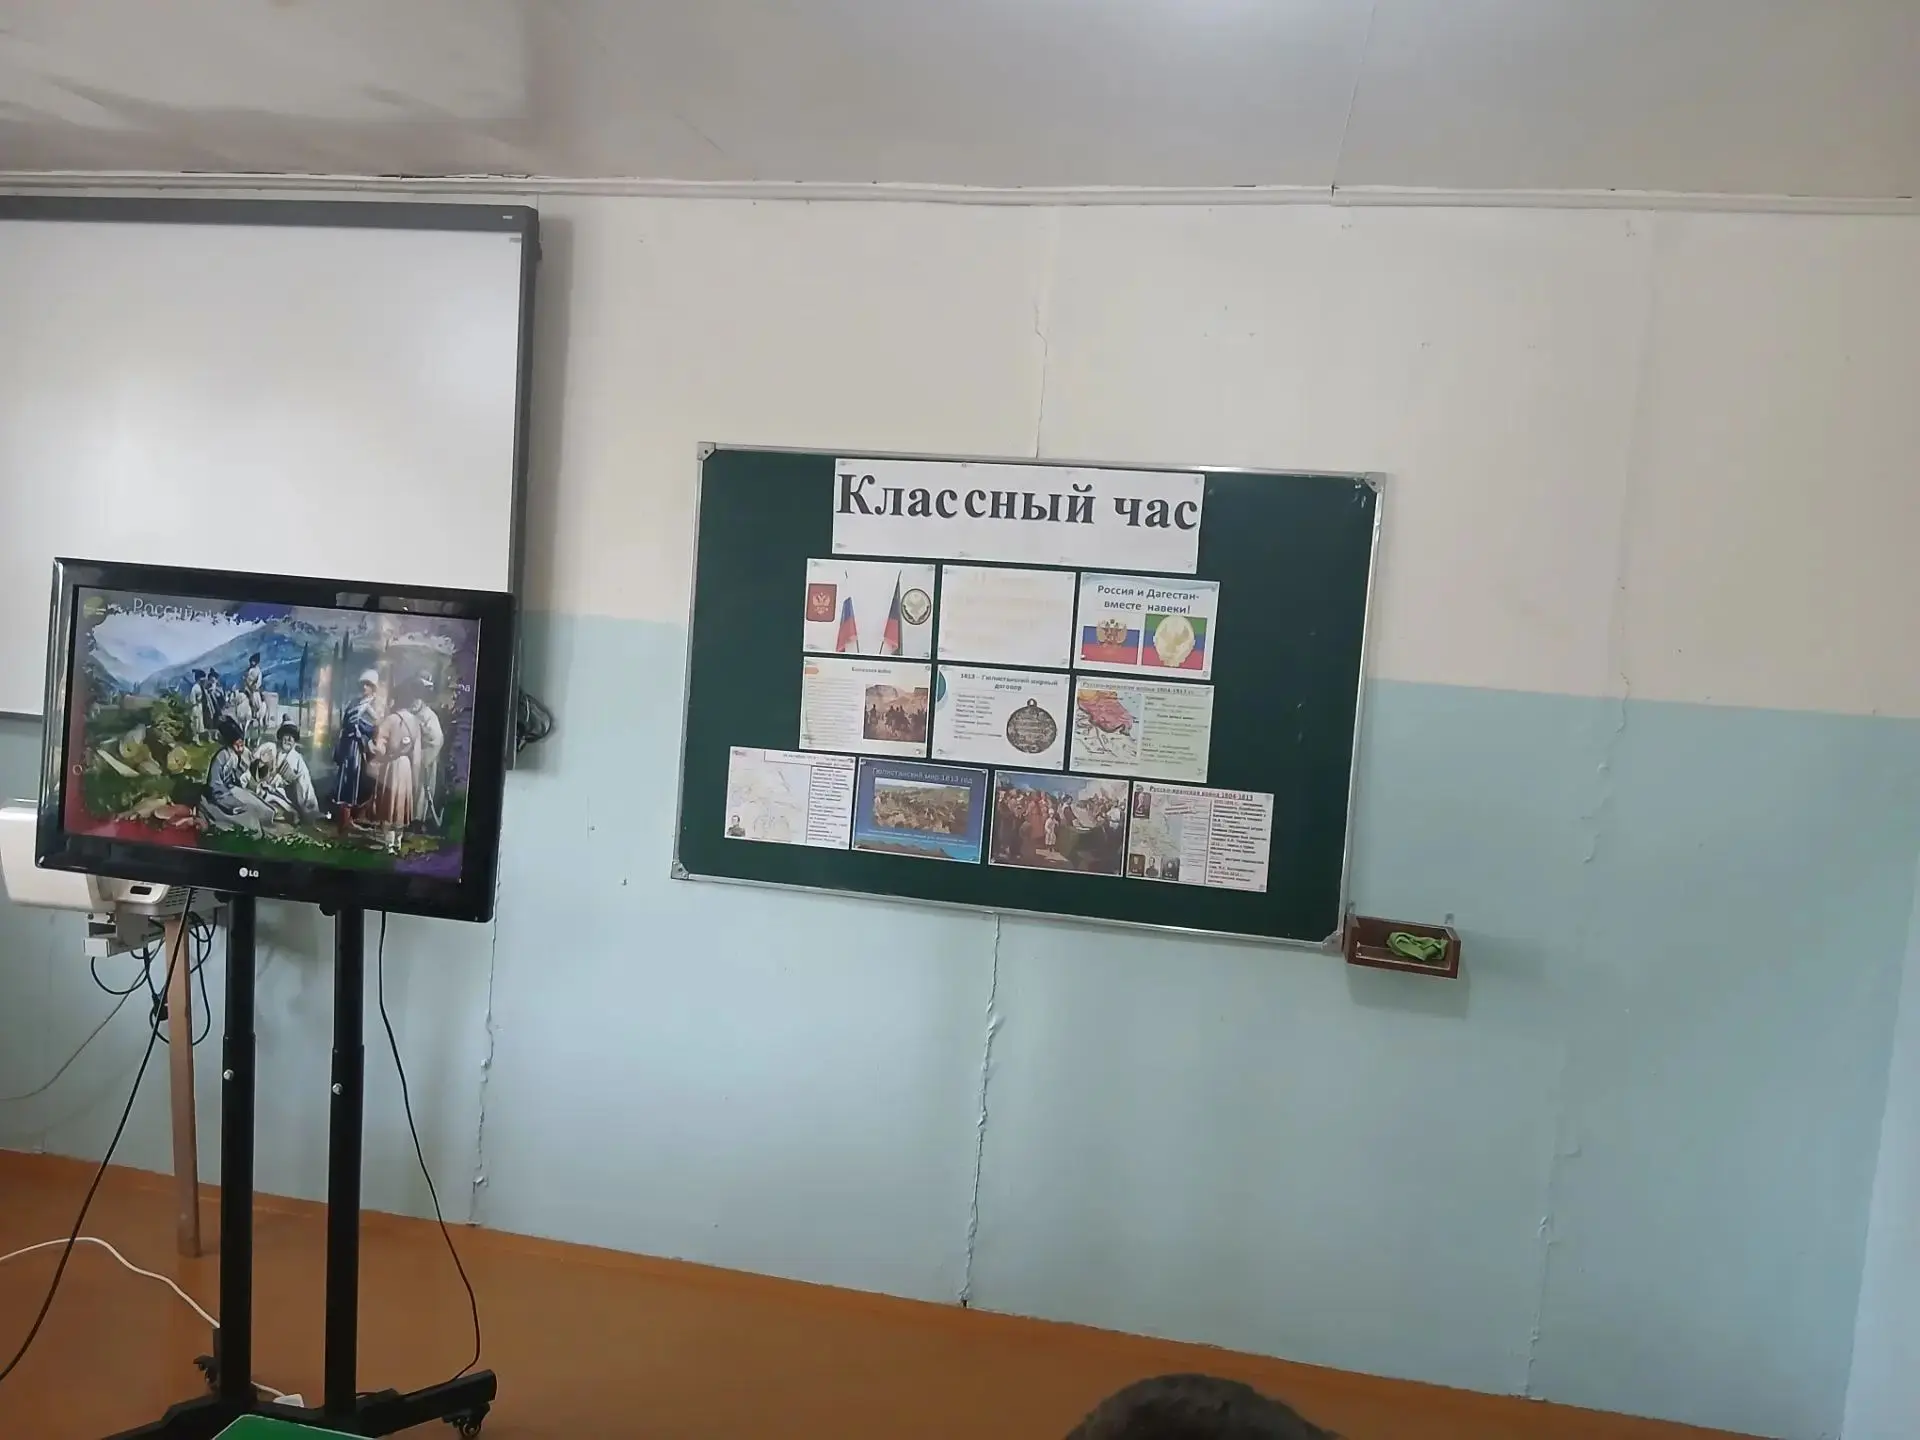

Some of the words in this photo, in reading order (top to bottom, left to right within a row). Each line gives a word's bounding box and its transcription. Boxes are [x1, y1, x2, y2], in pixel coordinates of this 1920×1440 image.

[836, 473, 1097, 525] Классный
[1113, 496, 1198, 530] час
[1097, 585, 1134, 596] Россия
[1146, 588, 1200, 601] Дагестан-
[1104, 601, 1142, 610] вместе
[1147, 604, 1191, 614] навеки!
